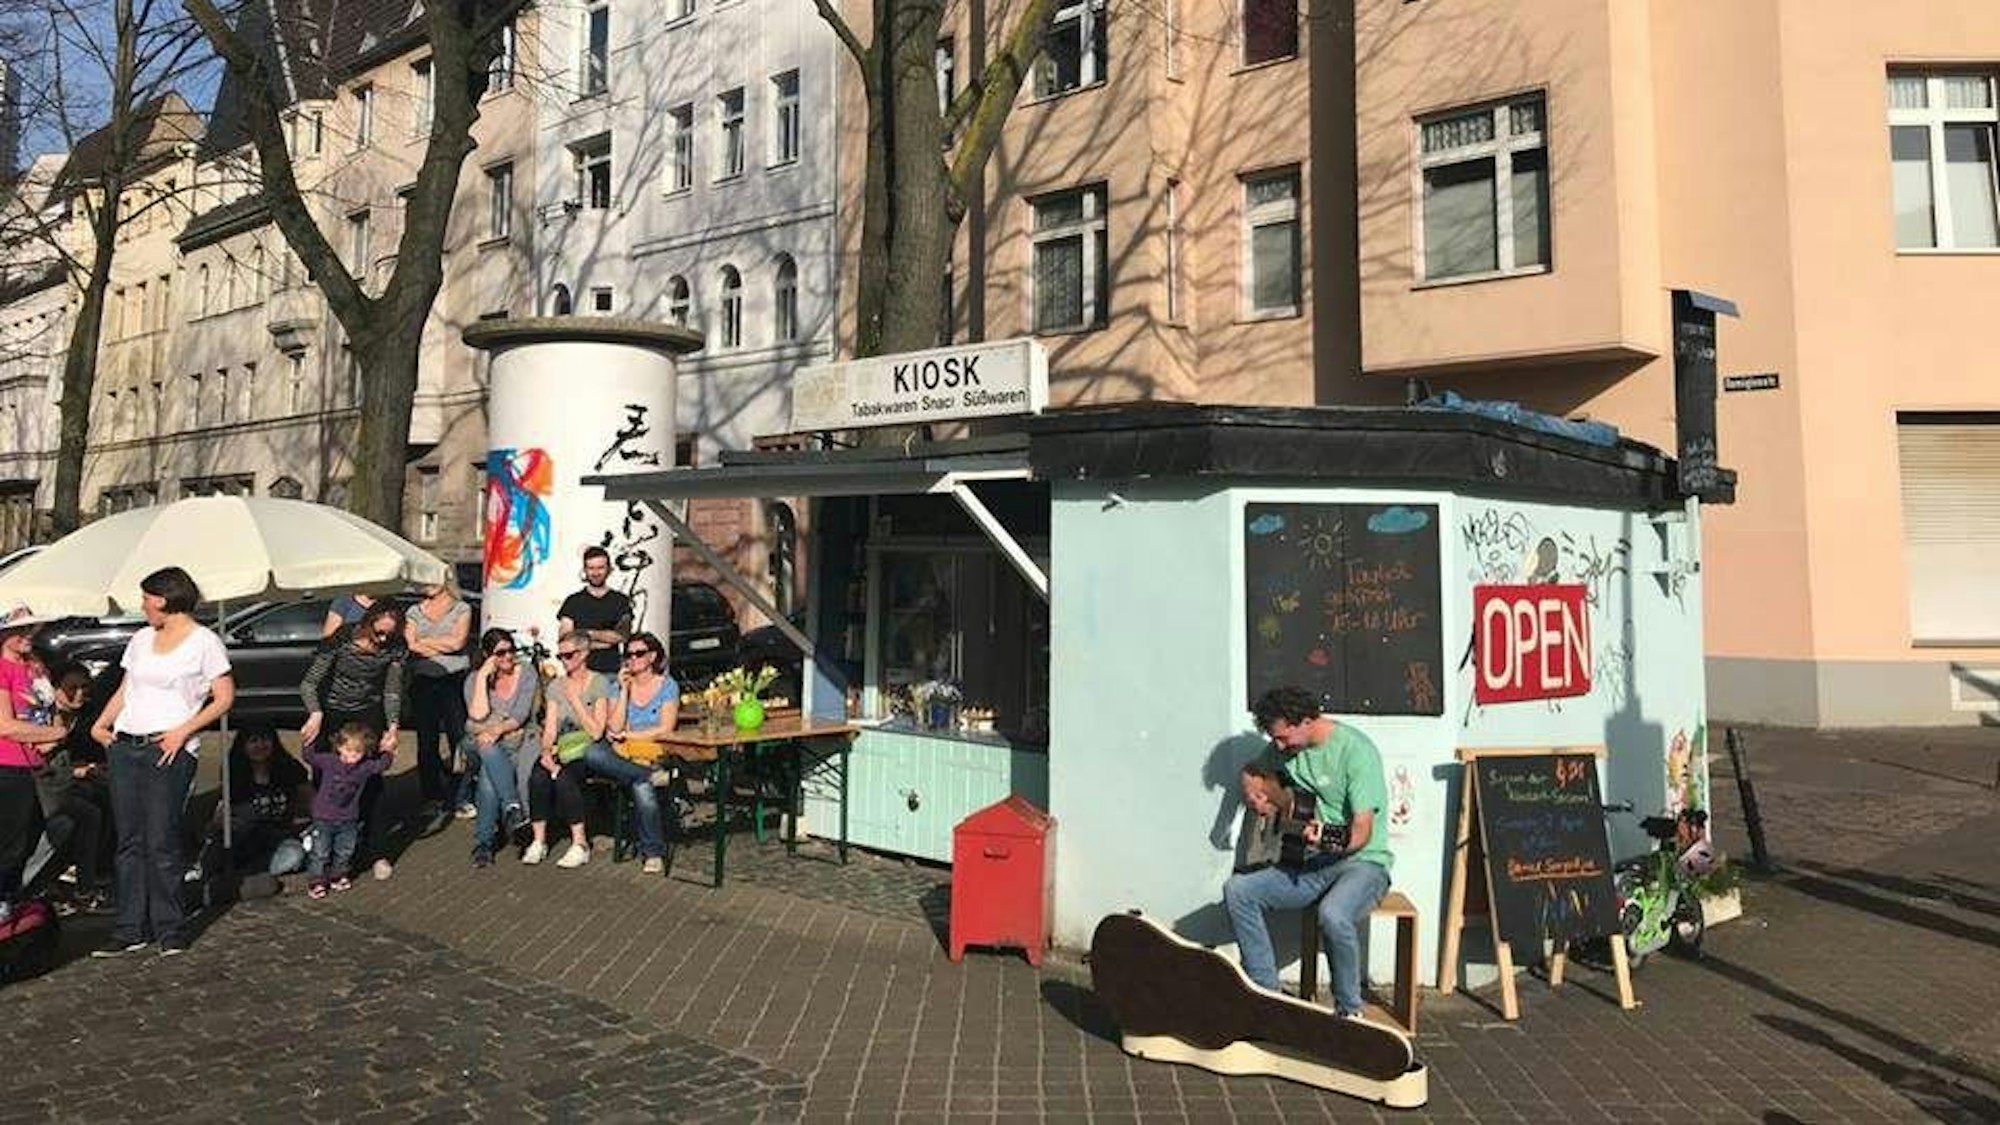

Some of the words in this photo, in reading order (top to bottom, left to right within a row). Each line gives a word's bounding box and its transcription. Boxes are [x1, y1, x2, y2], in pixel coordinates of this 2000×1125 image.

[894, 355, 981, 393] KIOSK
[851, 399, 918, 417] Tabakwaren
[963, 390, 1026, 407] Süßwaren
[1482, 596, 1591, 691] OPEN
